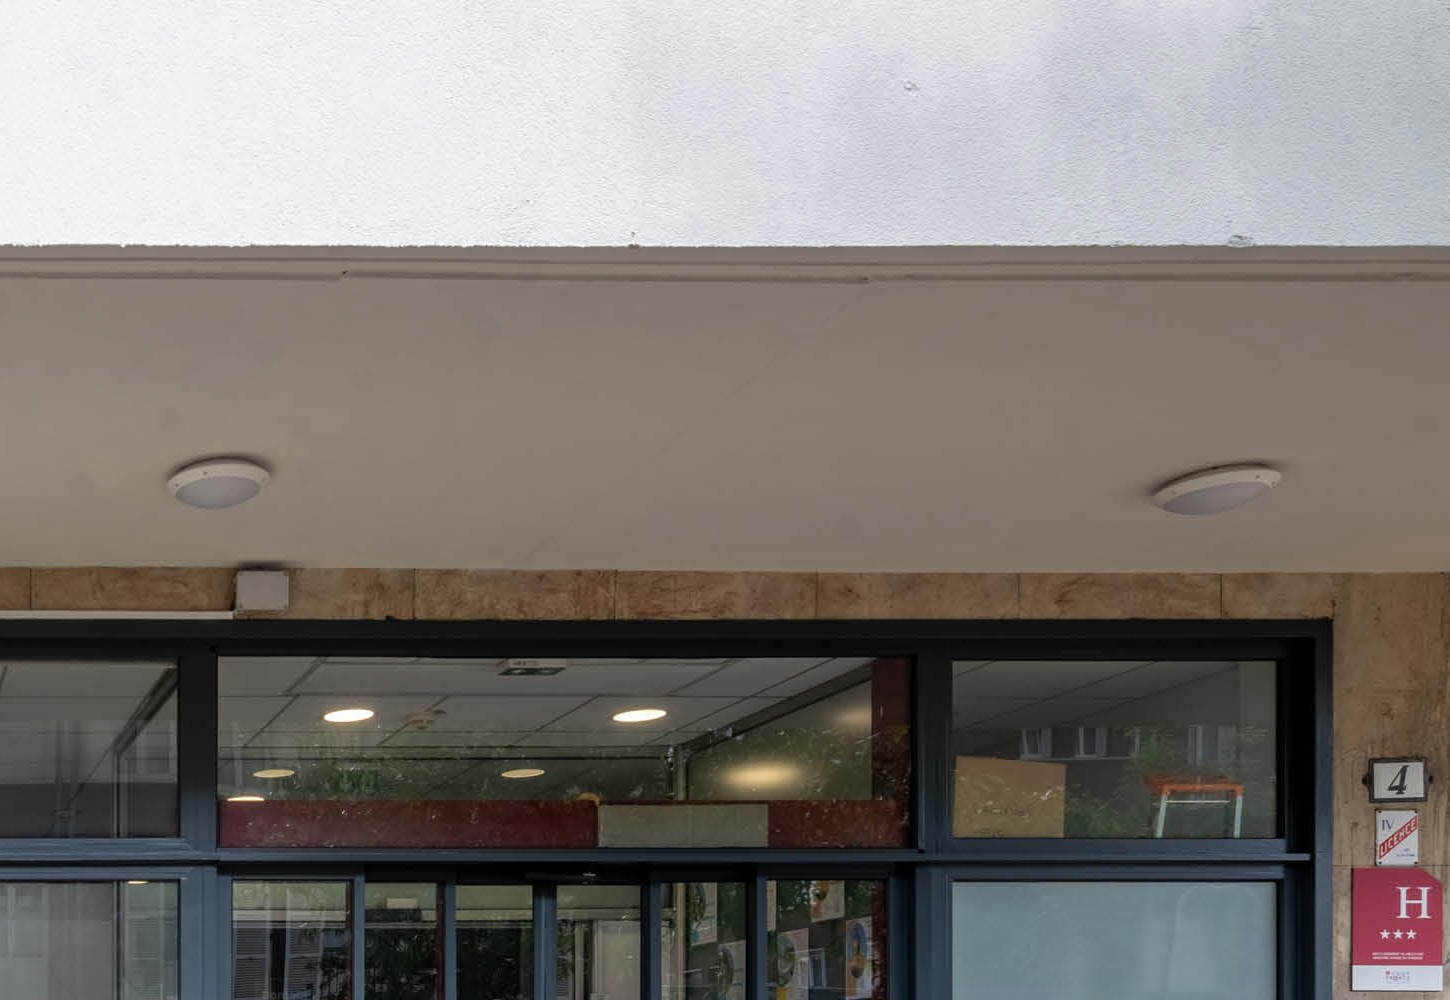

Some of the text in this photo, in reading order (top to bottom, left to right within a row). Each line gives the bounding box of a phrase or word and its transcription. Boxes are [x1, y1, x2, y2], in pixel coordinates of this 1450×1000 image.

[1388, 765, 1410, 795] 4
[1380, 817, 1418, 856] LICENCE
[1381, 819, 1395, 831] IV
[1395, 886, 1433, 919] H
